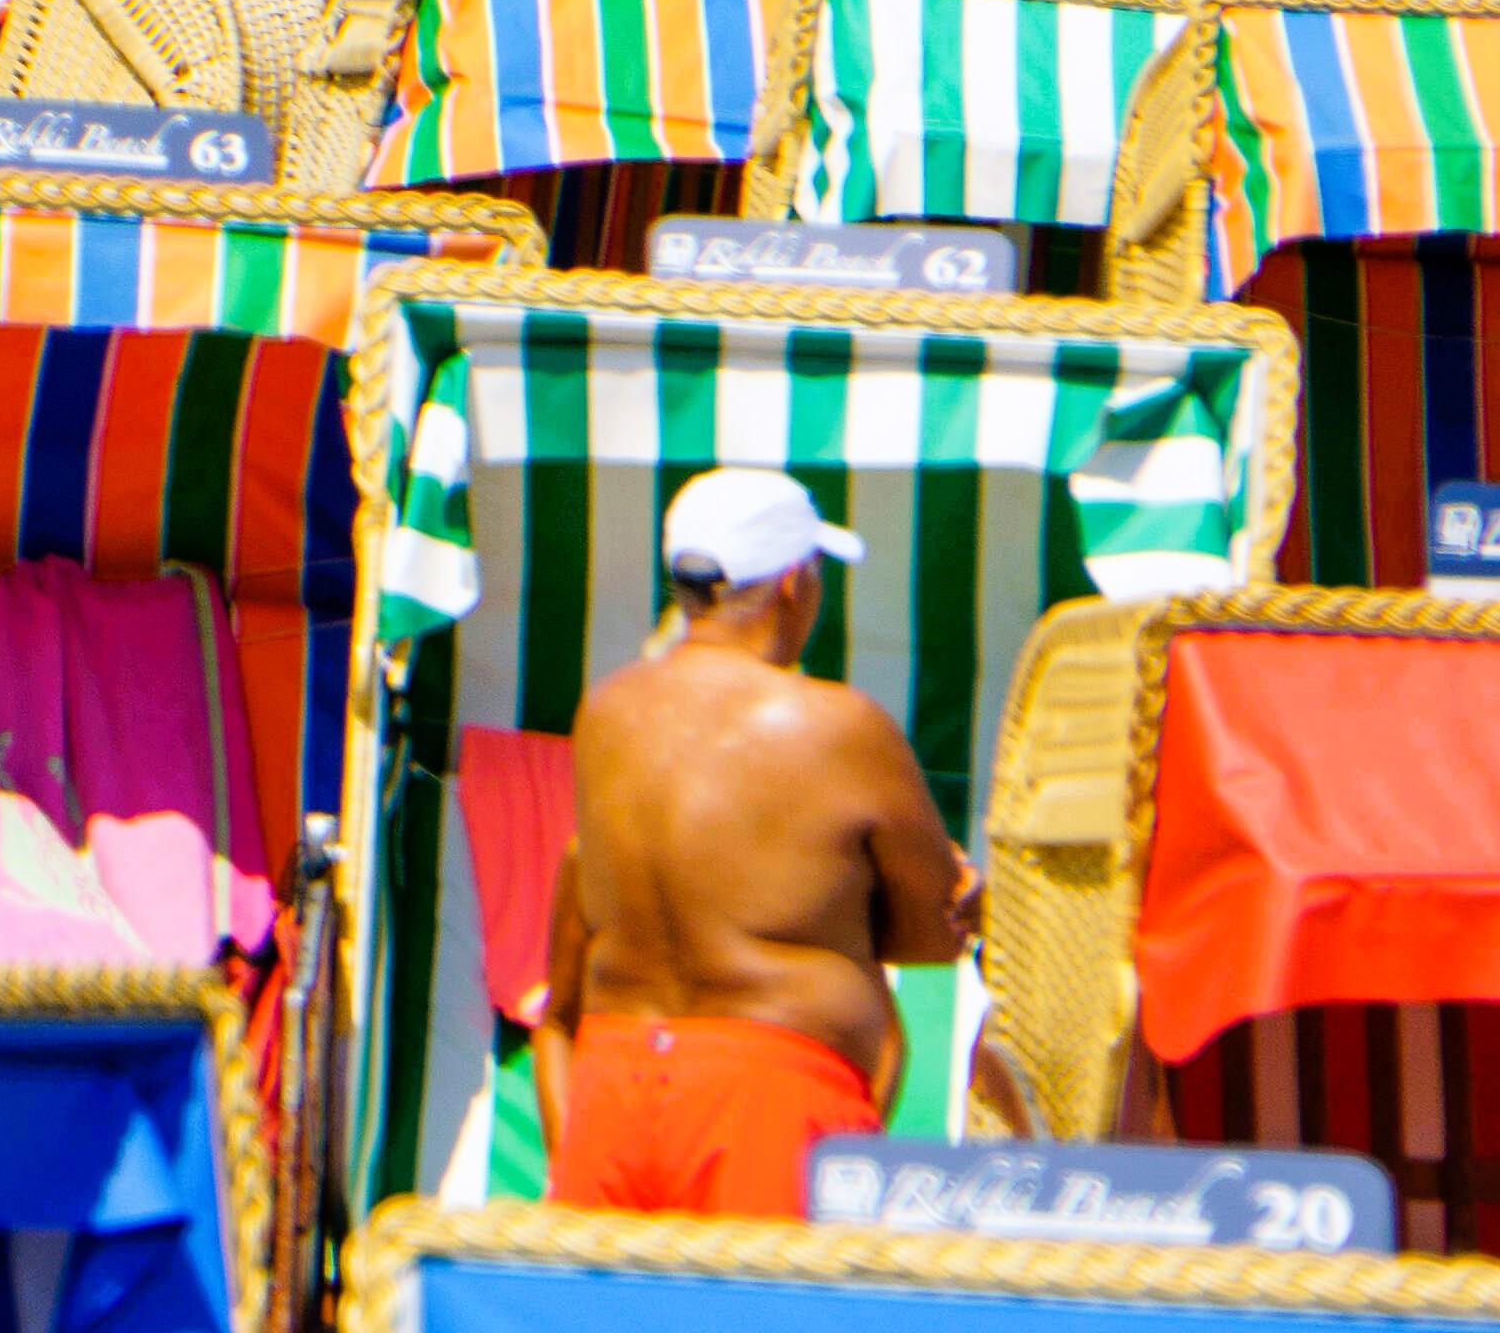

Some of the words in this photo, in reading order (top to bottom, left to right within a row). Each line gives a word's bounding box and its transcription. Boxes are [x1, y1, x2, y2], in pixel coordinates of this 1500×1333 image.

[76, 115, 191, 158] Beach
[189, 131, 250, 177] 63
[696, 231, 799, 277] Rikki
[800, 232, 924, 275] Beach
[922, 247, 988, 289] 62
[880, 1155, 1049, 1229] Rikki
[1052, 1158, 1248, 1227] Beach
[1249, 1184, 1353, 1252] 20
